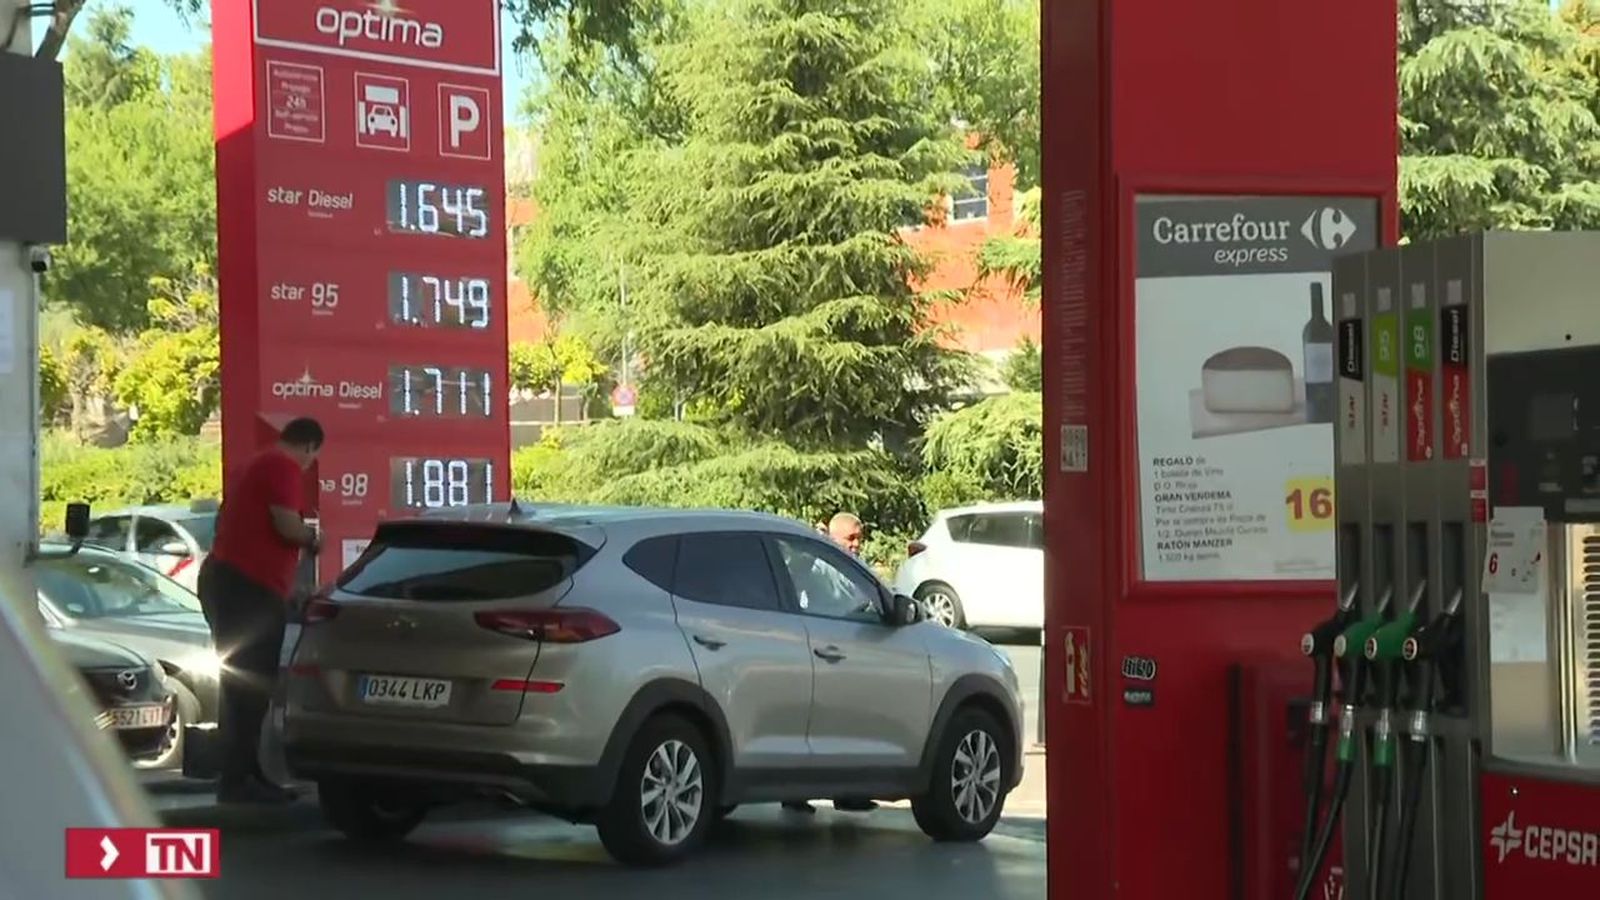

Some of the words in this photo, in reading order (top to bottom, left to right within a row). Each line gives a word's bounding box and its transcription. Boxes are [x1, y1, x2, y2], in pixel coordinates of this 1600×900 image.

[316, 7, 443, 47] optima
[451, 95, 480, 148] P
[267, 186, 303, 204] star
[308, 189, 353, 209] Diesel
[400, 183, 488, 236] 1.645
[1153, 213, 1291, 244] Carrefour
[1214, 247, 1288, 266] express
[271, 284, 305, 300] star
[312, 283, 338, 307] 95
[402, 276, 488, 328] 1.749
[1414, 325, 1425, 359] 98
[272, 381, 334, 399] optima
[338, 381, 382, 399] Diesel
[404, 367, 490, 416] 1.711
[1153, 457, 1193, 467] REGALO
[341, 473, 368, 497] 98
[405, 459, 492, 507] 1.881
[1285, 488, 1333, 520] 16
[368, 679, 406, 698] 0344
[412, 681, 445, 701] LKP
[1525, 826, 1598, 866] CEPSA
